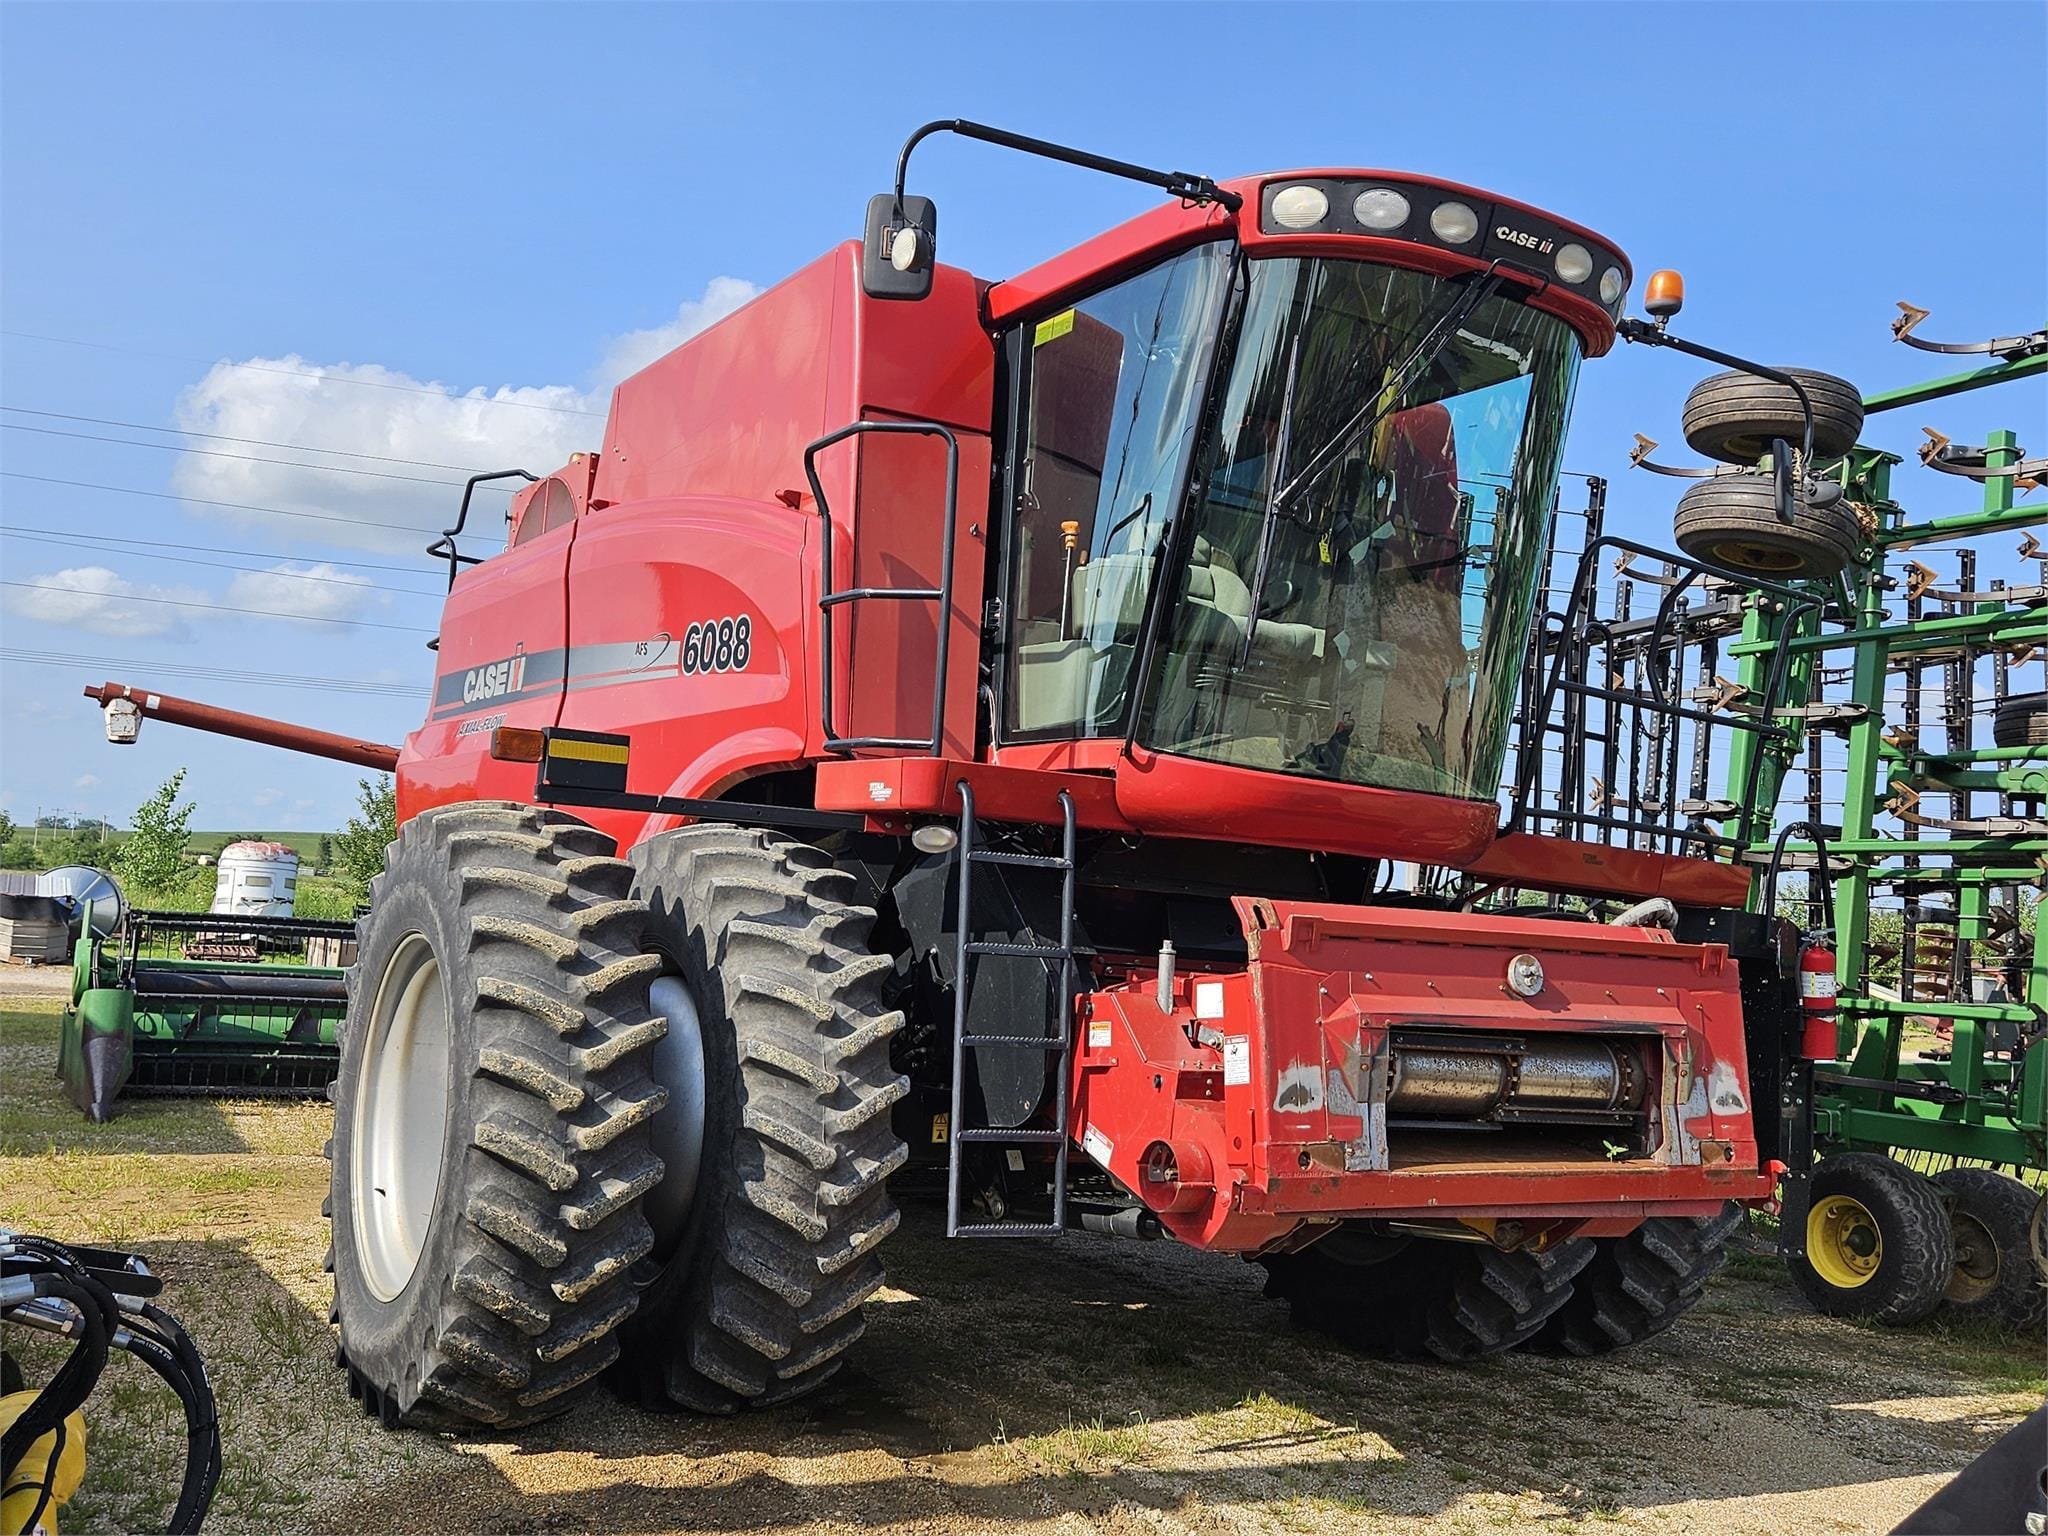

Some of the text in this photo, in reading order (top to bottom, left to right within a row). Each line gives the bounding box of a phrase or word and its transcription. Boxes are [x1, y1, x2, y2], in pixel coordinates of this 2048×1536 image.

[1496, 226, 1539, 249] CASE
[634, 642, 648, 656] AFS
[682, 614, 751, 676] 6088
[463, 661, 509, 704] CASE
[456, 713, 507, 737] AXIAL-FLOW
